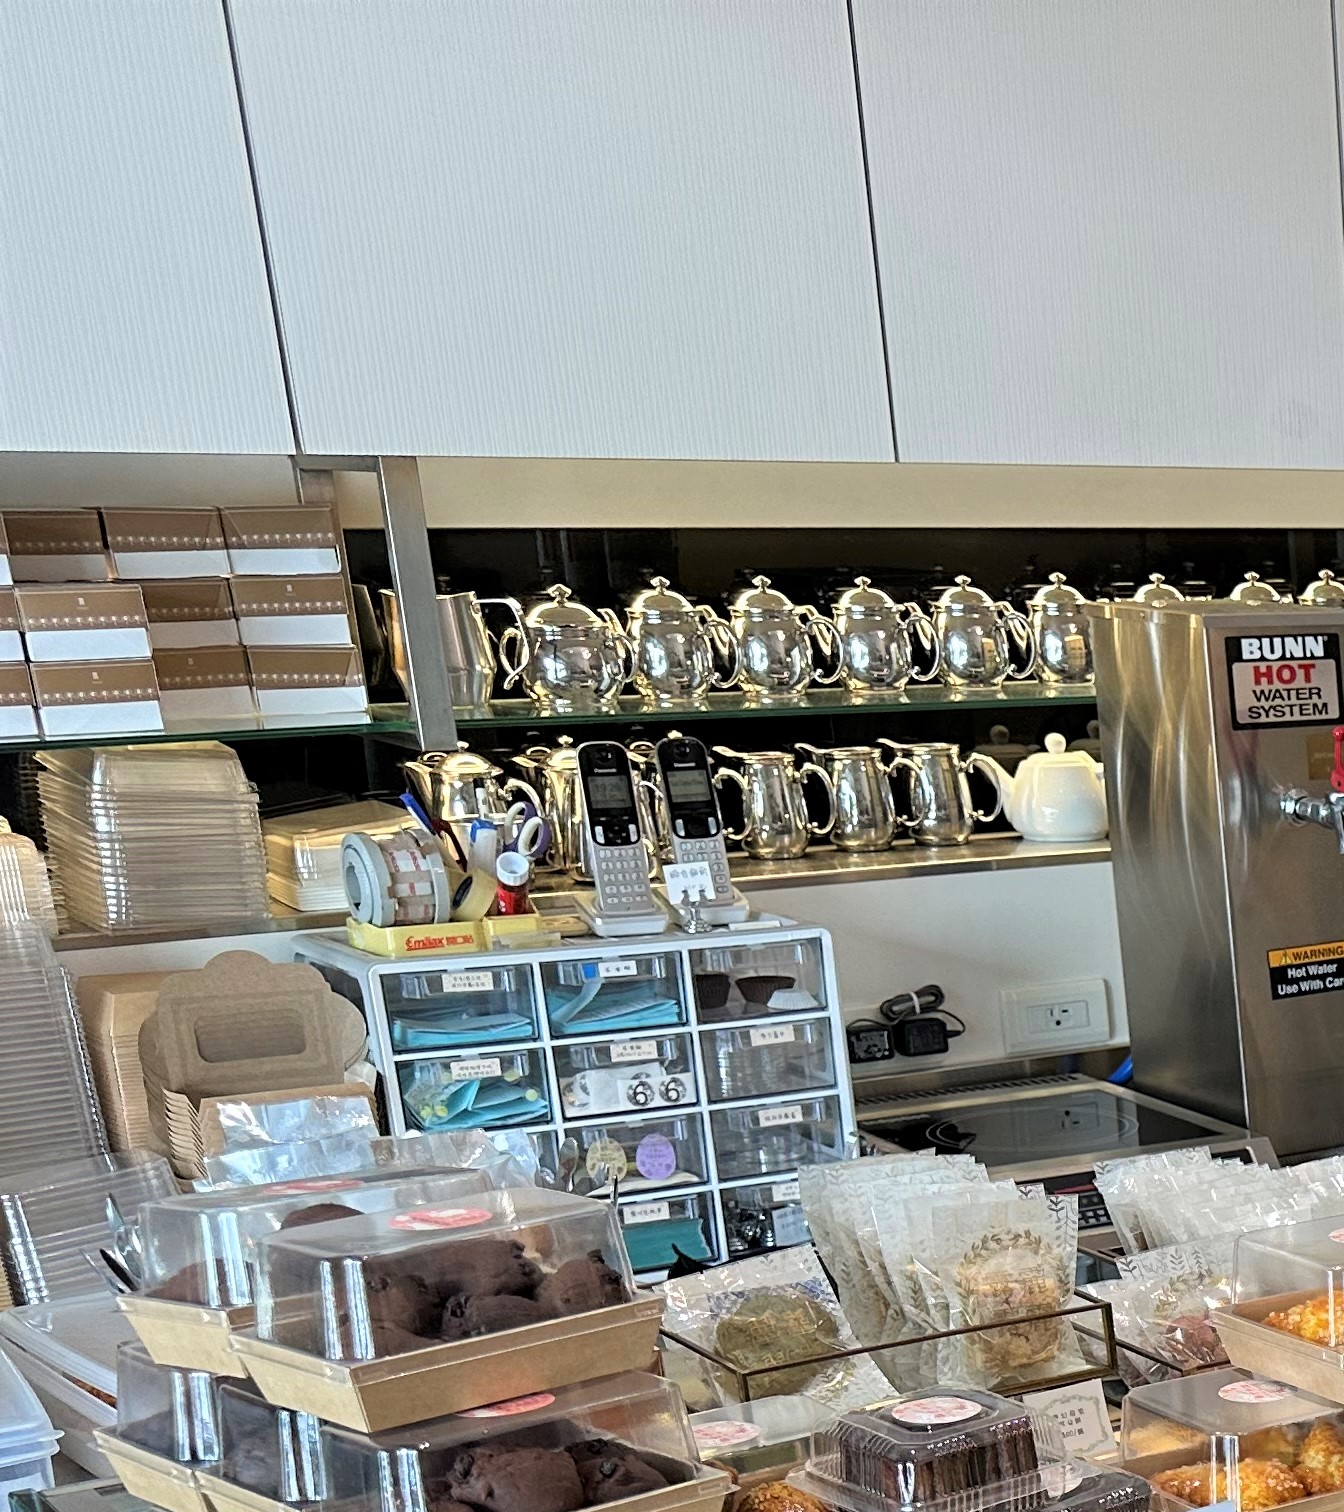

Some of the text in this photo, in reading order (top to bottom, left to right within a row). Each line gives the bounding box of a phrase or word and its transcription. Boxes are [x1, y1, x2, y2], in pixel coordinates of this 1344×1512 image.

[1241, 635, 1325, 660] BUNN
[1253, 664, 1312, 686] HOT
[1252, 687, 1323, 702] WATER
[1248, 702, 1329, 719] SYSTEM
[1292, 946, 1344, 962] WARNING
[1287, 964, 1338, 979] Hot Water
[1277, 984, 1299, 995] Use
[1299, 979, 1324, 992] With
